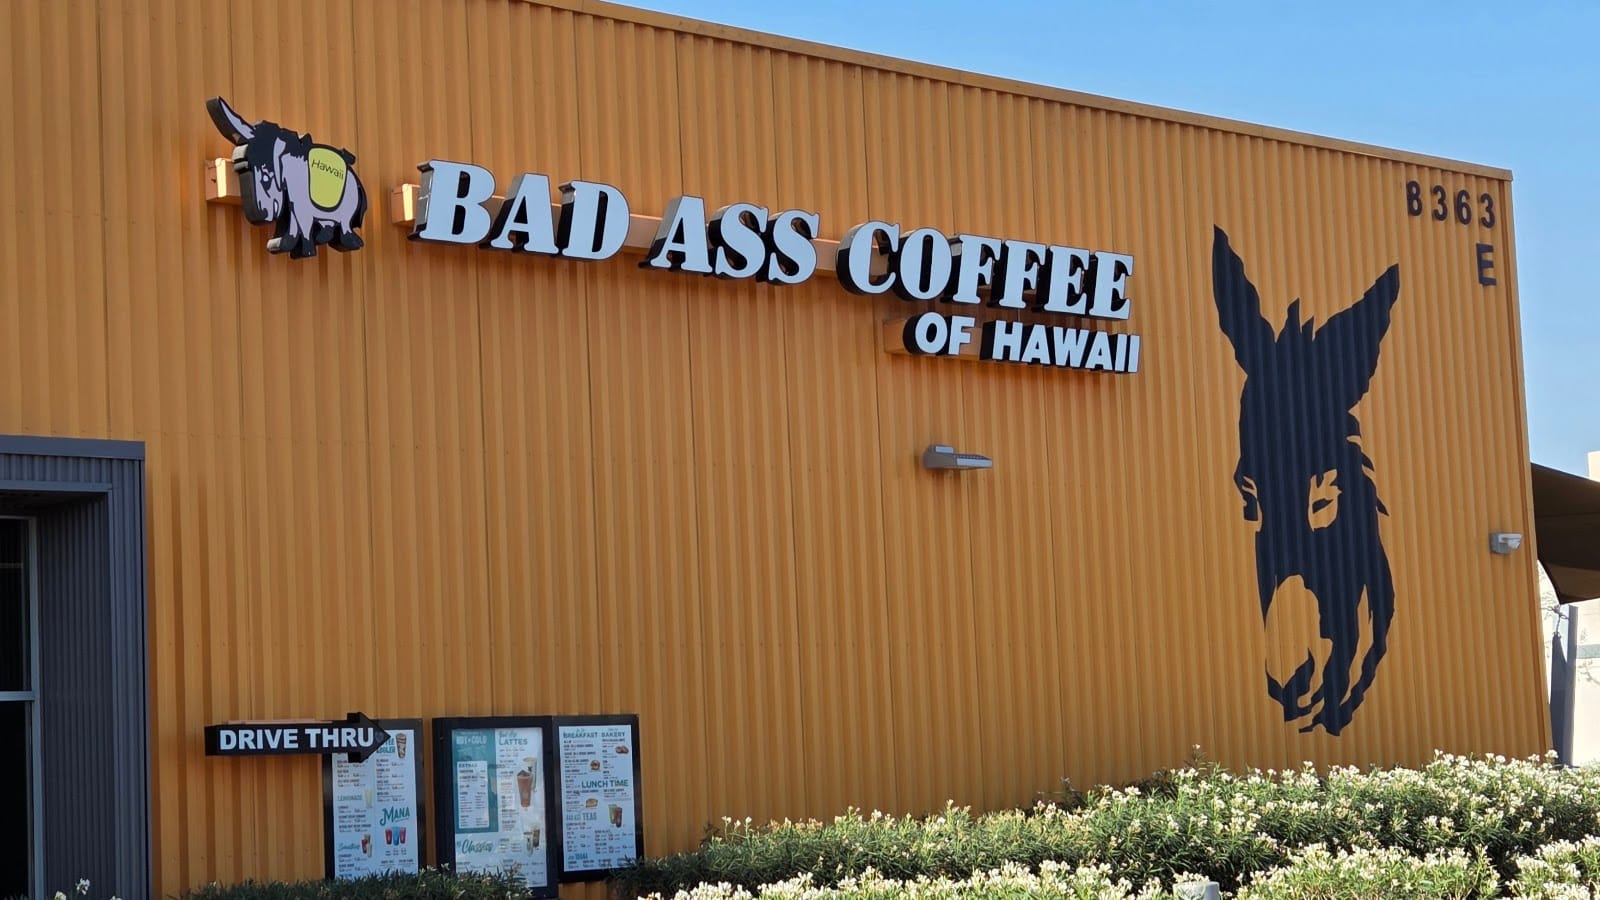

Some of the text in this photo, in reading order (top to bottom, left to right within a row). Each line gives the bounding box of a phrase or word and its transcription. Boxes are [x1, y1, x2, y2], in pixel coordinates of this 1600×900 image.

[311, 159, 344, 180] Hawaii
[1406, 180, 1496, 229] 8363
[416, 159, 1135, 320] BAD ASS COFFEE
[1475, 242, 1497, 287] E
[913, 311, 1141, 373] OF HAWAII
[219, 728, 299, 751] DRIVE
[304, 727, 374, 748] THRU
[498, 738, 529, 746] LATTES
[562, 731, 598, 739] BREAKFAST
[581, 780, 609, 789] LUNCH
[610, 779, 629, 787] TIME
